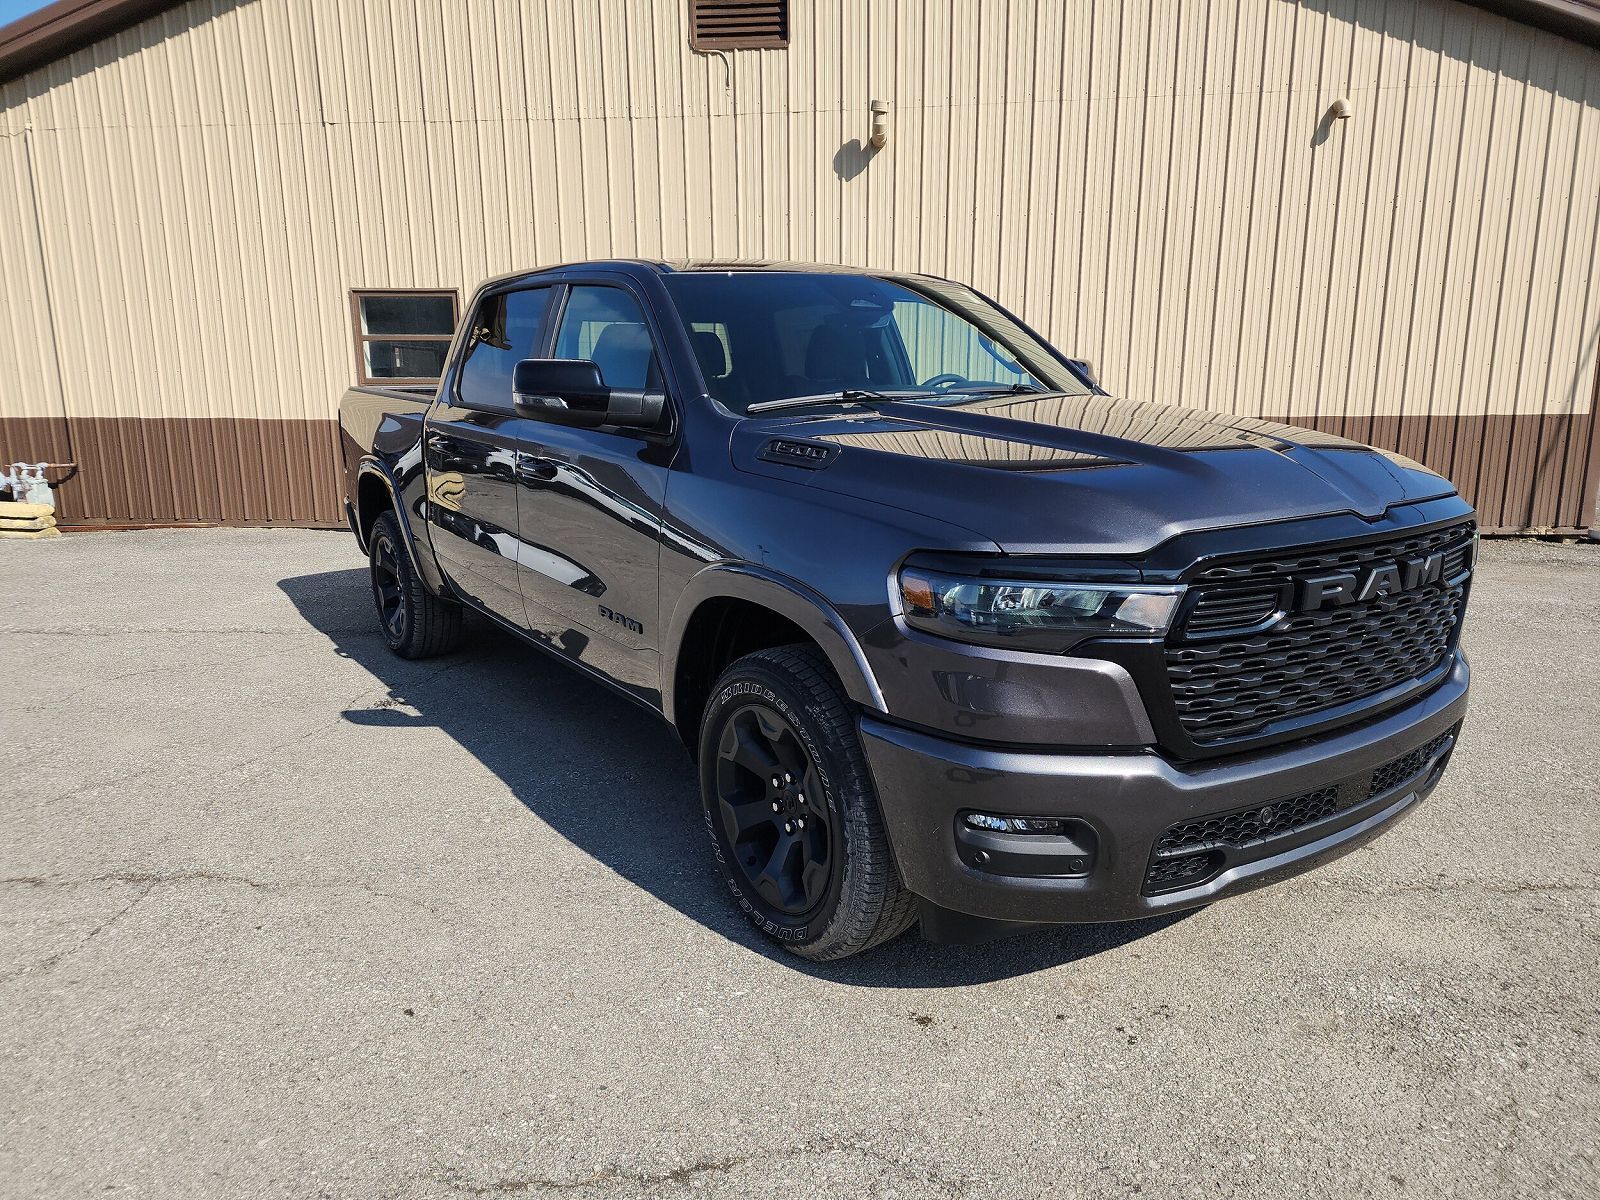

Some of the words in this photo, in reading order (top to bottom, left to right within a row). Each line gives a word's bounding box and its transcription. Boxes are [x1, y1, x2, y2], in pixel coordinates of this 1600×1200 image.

[1302, 552, 1443, 611] RAM
[598, 604, 643, 634] RAM
[720, 682, 837, 813] BRIDGESTONE
[727, 877, 808, 941] DUELER
